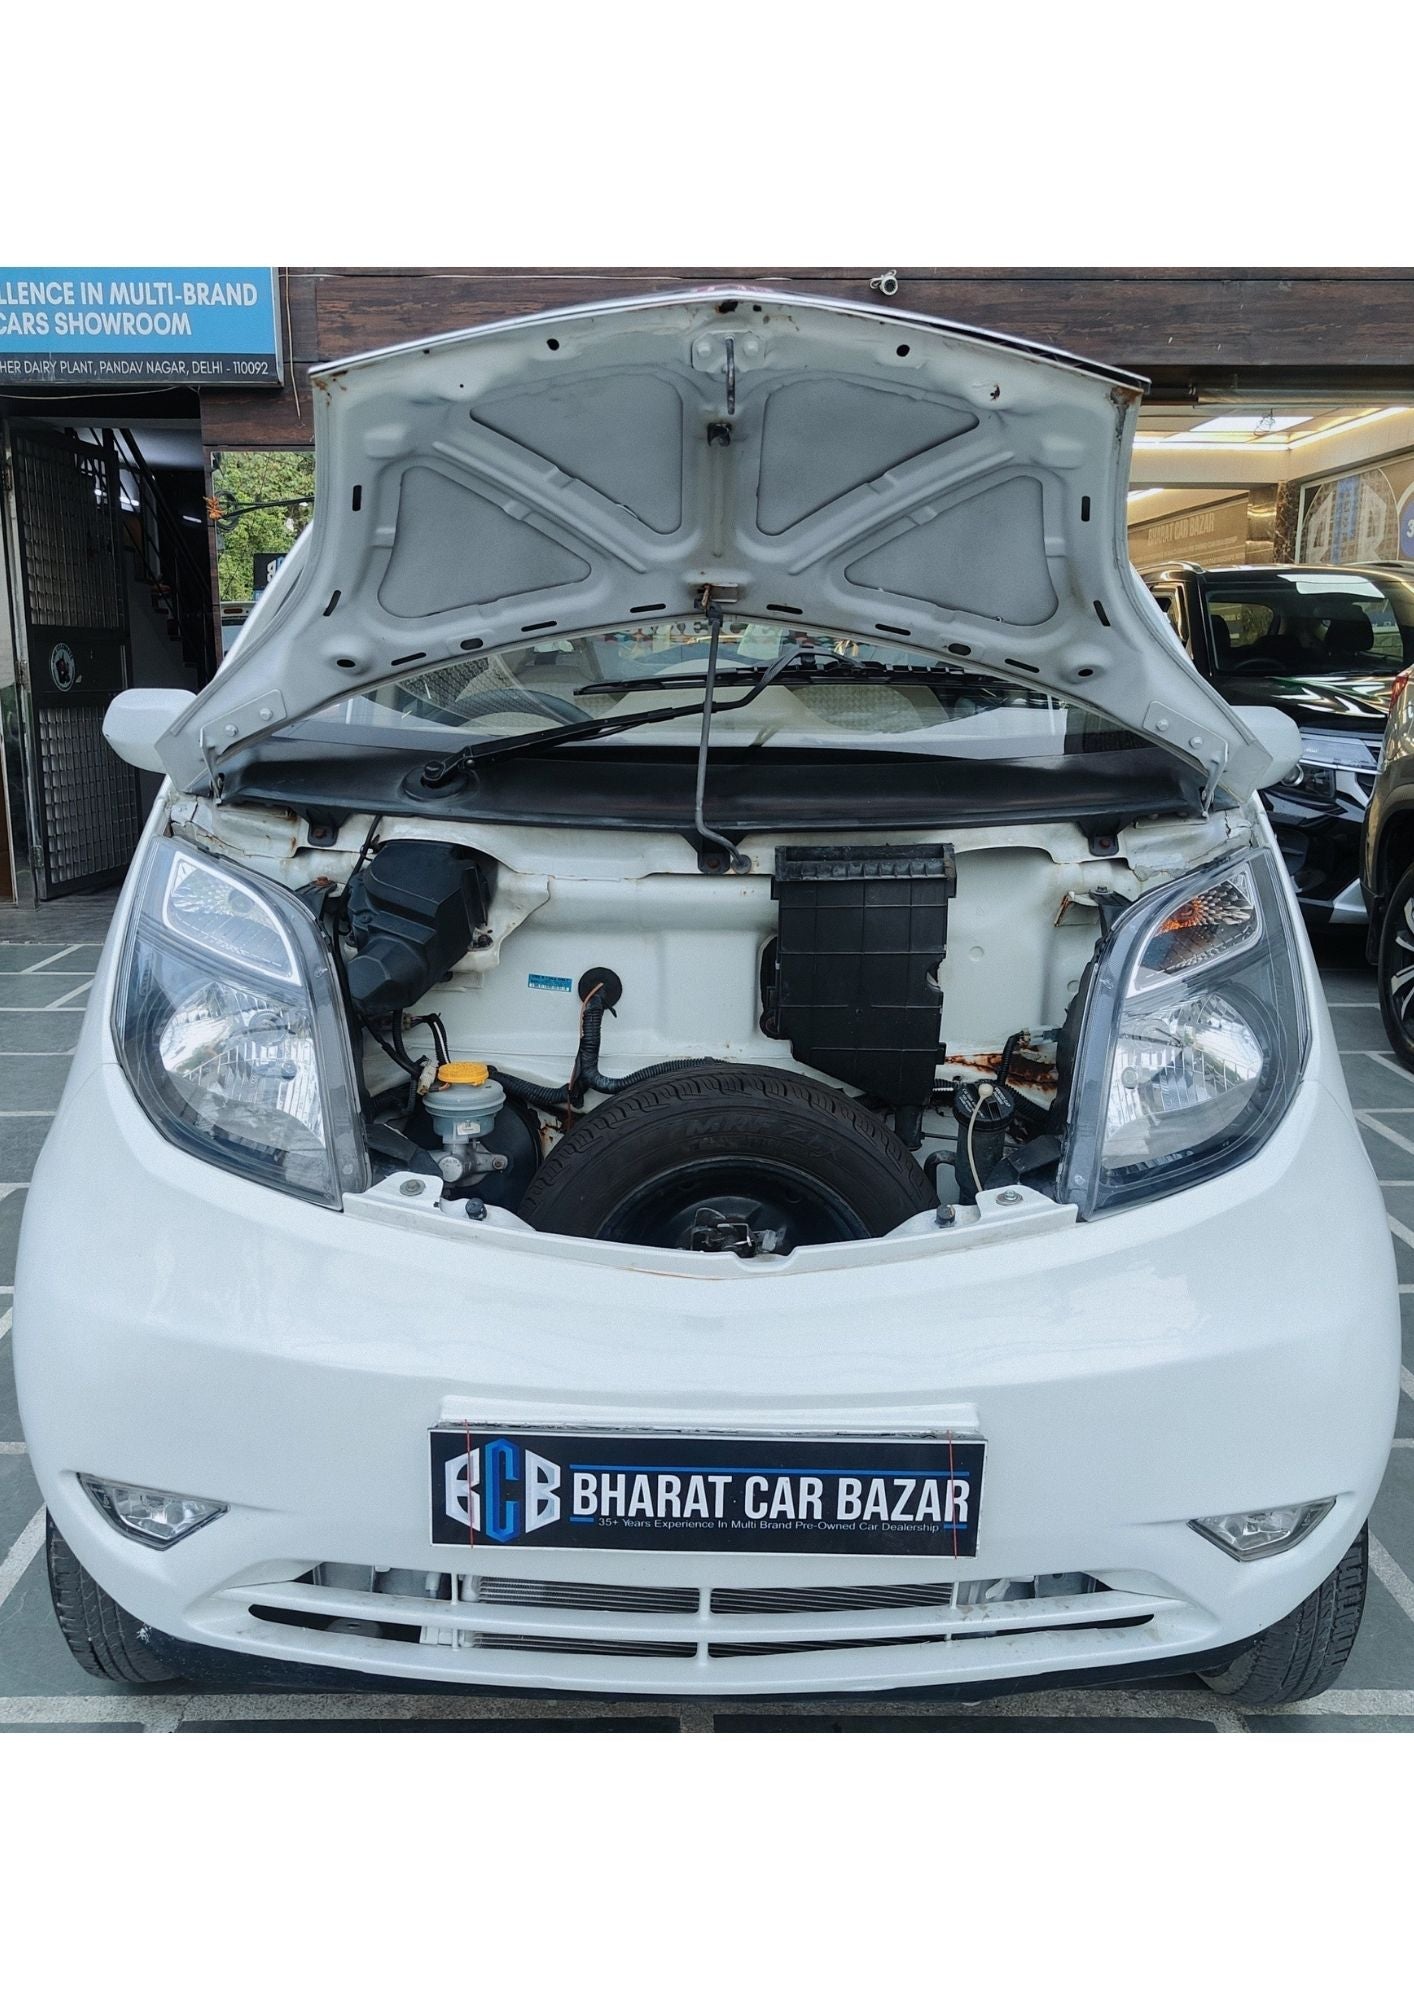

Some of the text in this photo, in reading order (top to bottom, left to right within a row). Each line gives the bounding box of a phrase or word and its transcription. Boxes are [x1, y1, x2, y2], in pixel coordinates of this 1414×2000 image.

[81, 282, 102, 305] IN
[109, 282, 258, 306] MULTI-BRAND
[55, 312, 193, 336] SHOWROOM
[0, 360, 21, 374] HER
[24, 360, 57, 374] DAIRY
[60, 360, 98, 376] PLANT,
[100, 360, 143, 374] PANDAV
[146, 361, 190, 377] NAGAR,
[193, 361, 223, 375] DELHI
[232, 361, 269, 375] 110092
[572, 1472, 971, 1523] BHARAT CAR BAZAR
[598, 1517, 939, 1533] 35+ Years Experience In Multi Brand Pre-Owned Car Dealership
